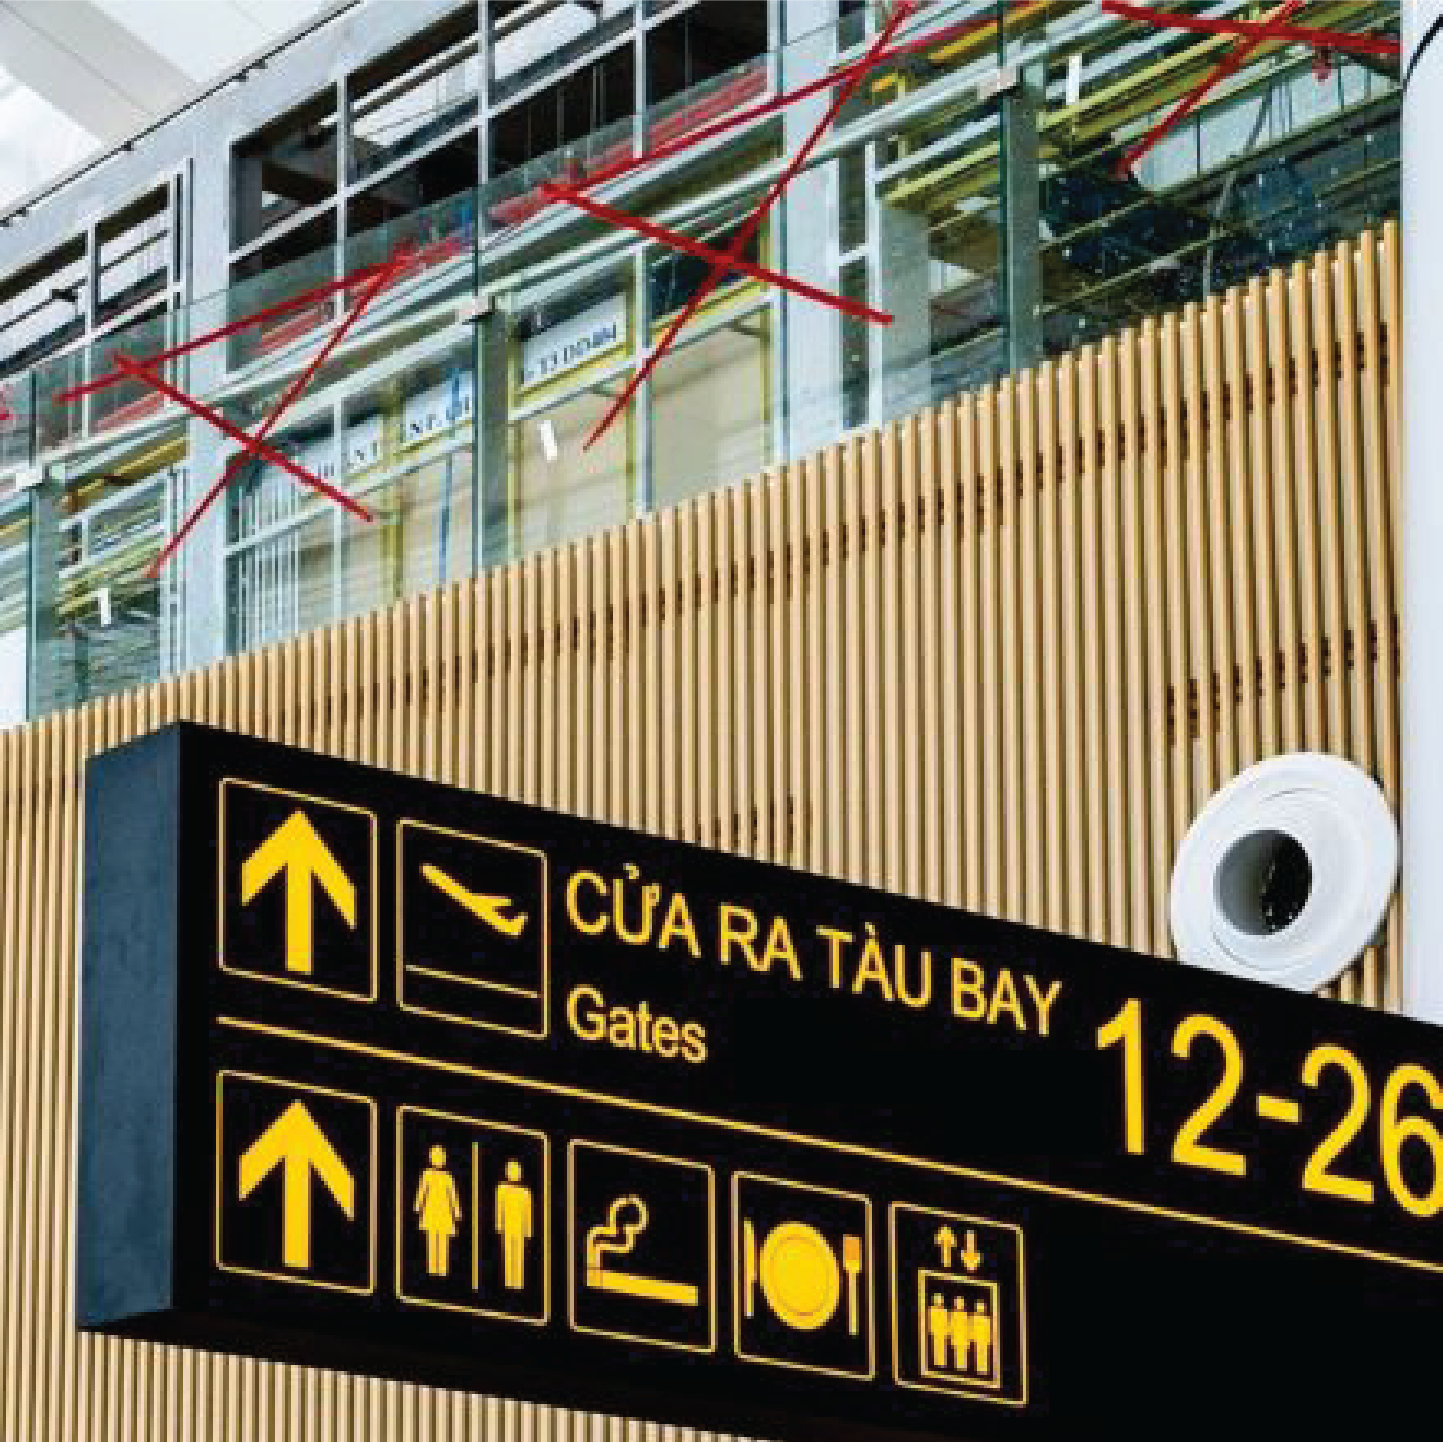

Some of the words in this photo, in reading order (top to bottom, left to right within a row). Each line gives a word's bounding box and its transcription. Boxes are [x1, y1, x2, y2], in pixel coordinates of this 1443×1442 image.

[565, 861, 703, 958] CỬA
[719, 903, 804, 982] RA
[815, 921, 933, 1009] TÀU
[951, 957, 1063, 1038] BAY
[565, 983, 709, 1064] Gates
[1095, 996, 1443, 1219] 12-26
